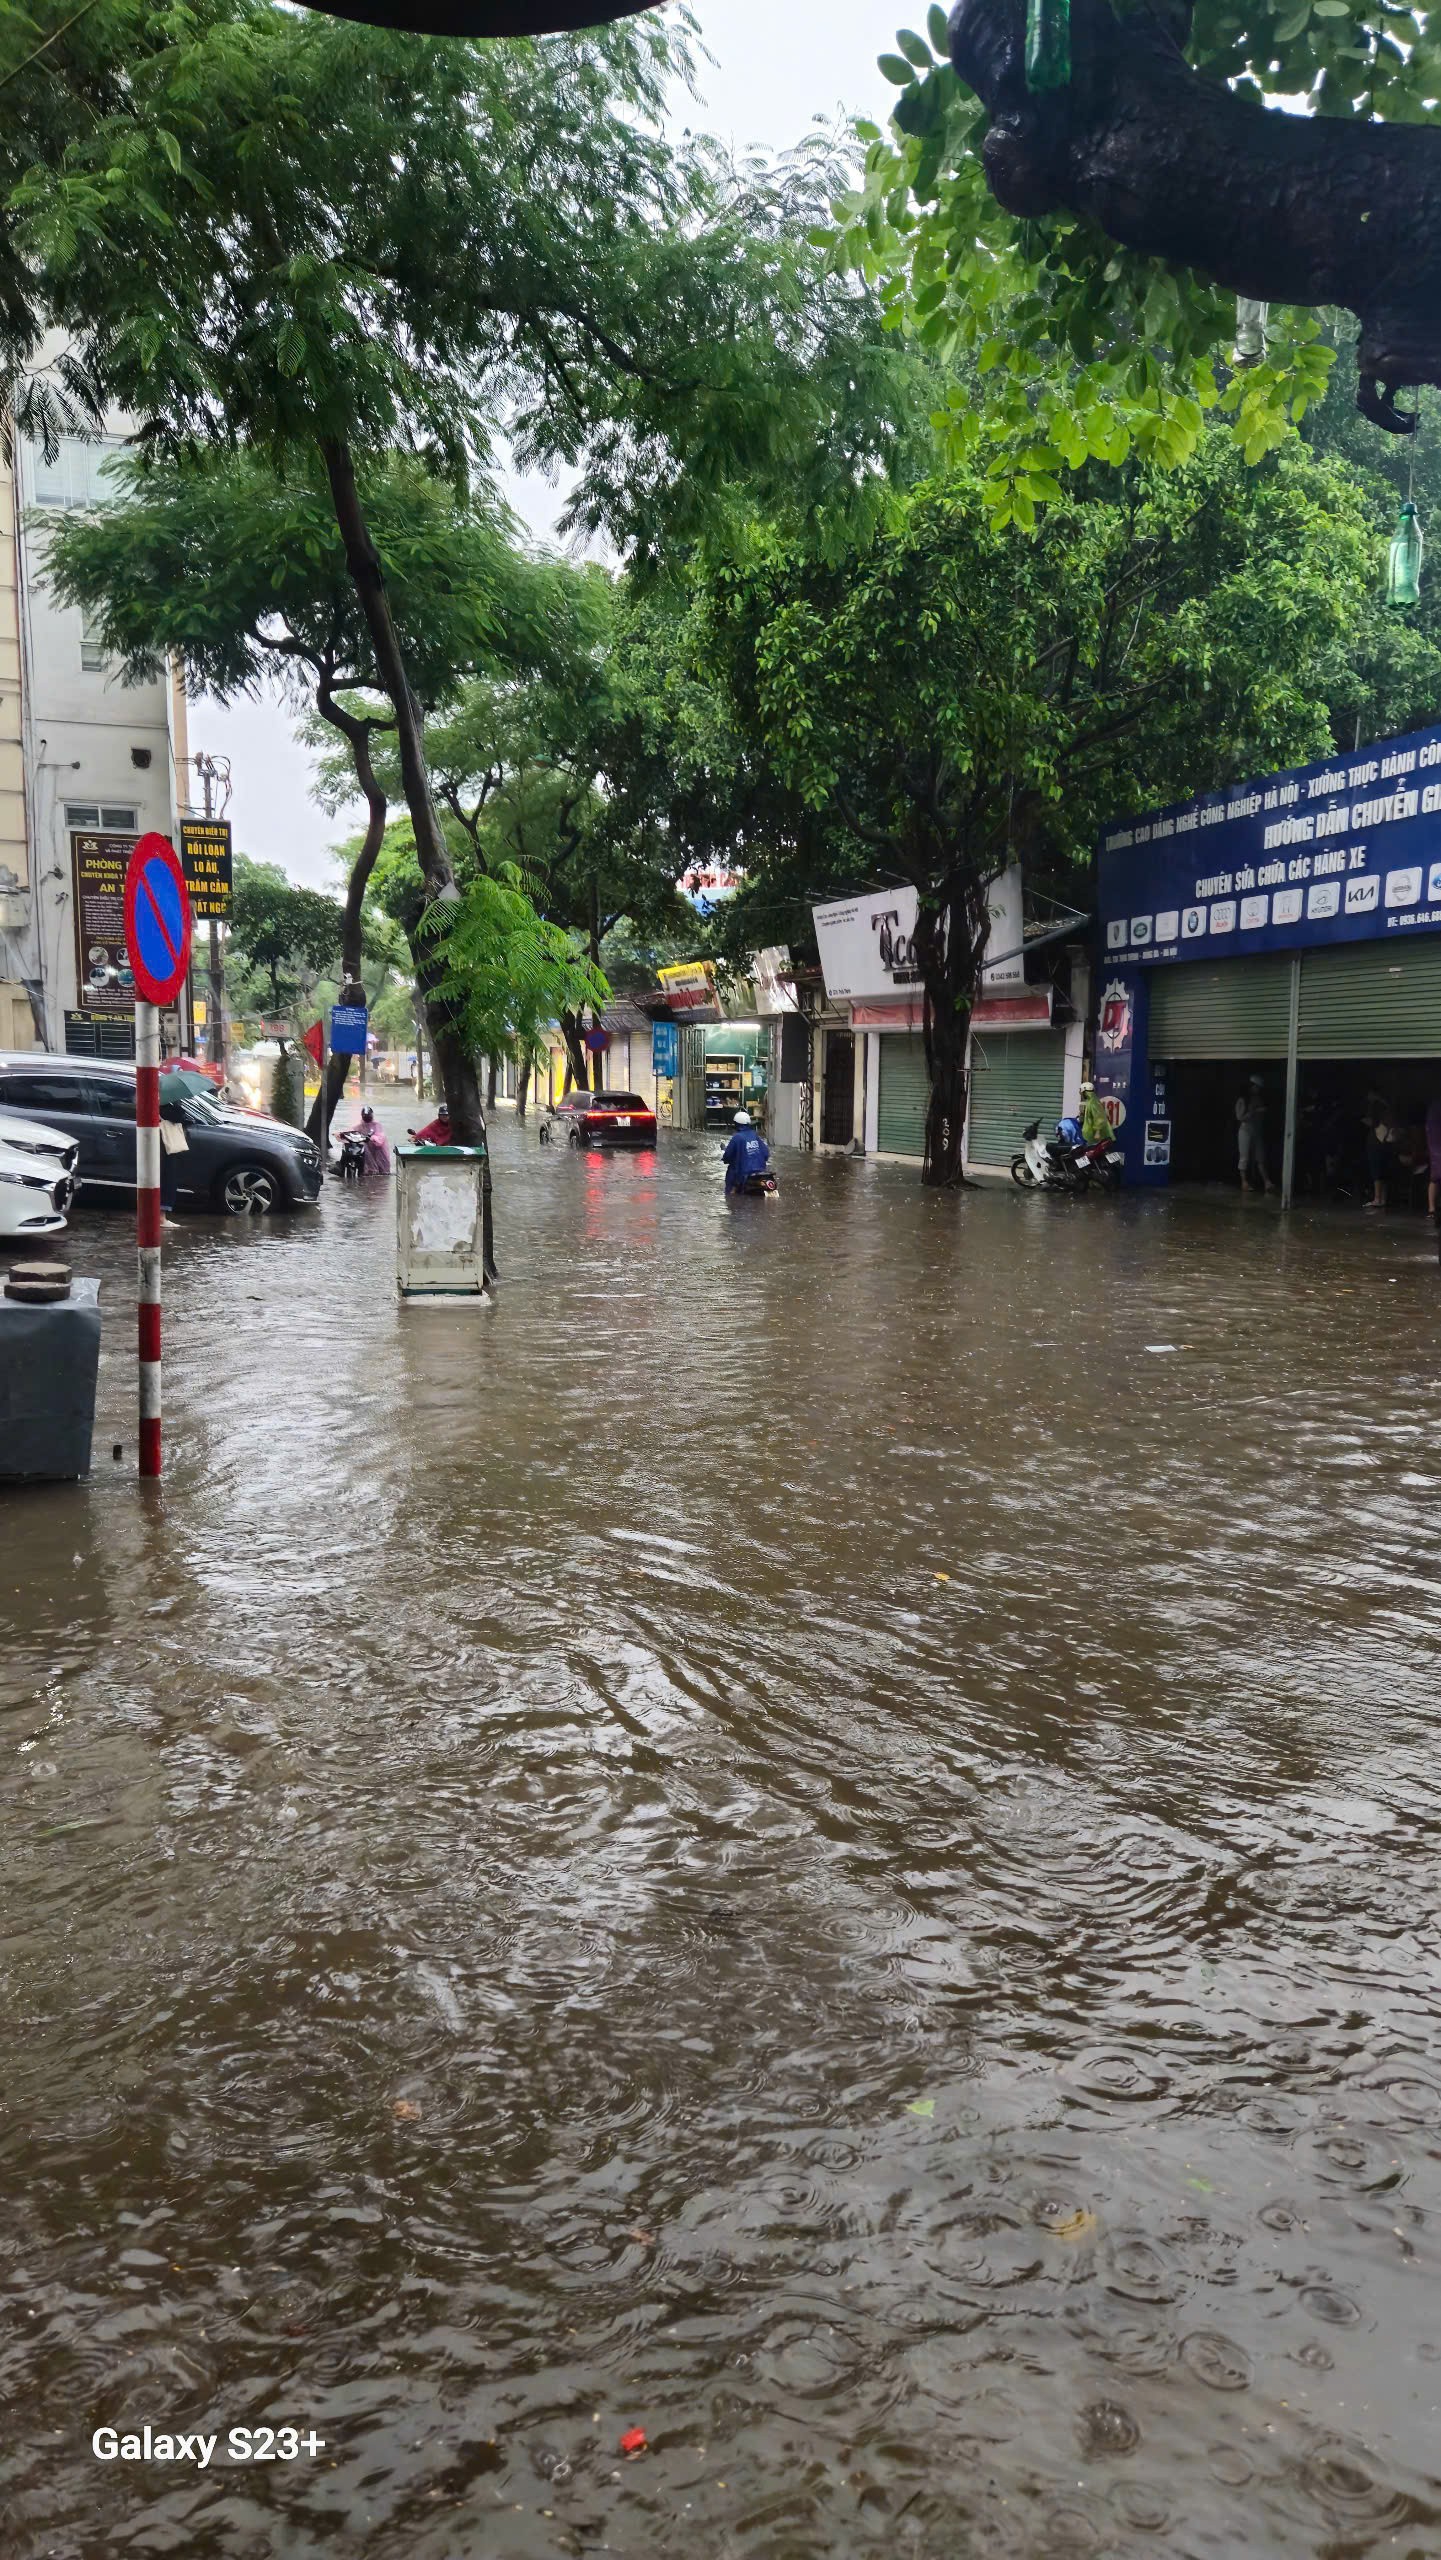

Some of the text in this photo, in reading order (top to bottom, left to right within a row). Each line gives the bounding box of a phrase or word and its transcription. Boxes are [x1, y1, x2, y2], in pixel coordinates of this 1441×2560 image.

[1200, 804, 1225, 826] CÔNG
[1227, 792, 1262, 819] NGHIỆP
[1264, 785, 1278, 810] HÀ
[1279, 780, 1299, 808] NỘI
[1308, 768, 1346, 799] XƯỞNG
[1348, 761, 1379, 788] THỰC
[1381, 751, 1416, 779] HÀNH
[1264, 814, 1314, 849] HƯỚNG
[1316, 800, 1350, 838] DẪN
[1351, 778, 1419, 829] CHUYỂN
[187, 840, 226, 858] RỐI LOẠN
[85, 858, 122, 870] PHÒNG
[193, 861, 204, 873] LO
[1195, 871, 1232, 898] CHUYÊN
[1235, 863, 1255, 891] SỬA
[1258, 858, 1286, 887] CHỮA
[1288, 854, 1311, 881] CÁC
[1349, 845, 1367, 869] XE
[100, 883, 116, 893] AN
[196, 898, 208, 913] ẤT
[1104, 1101, 1120, 1126] 31
